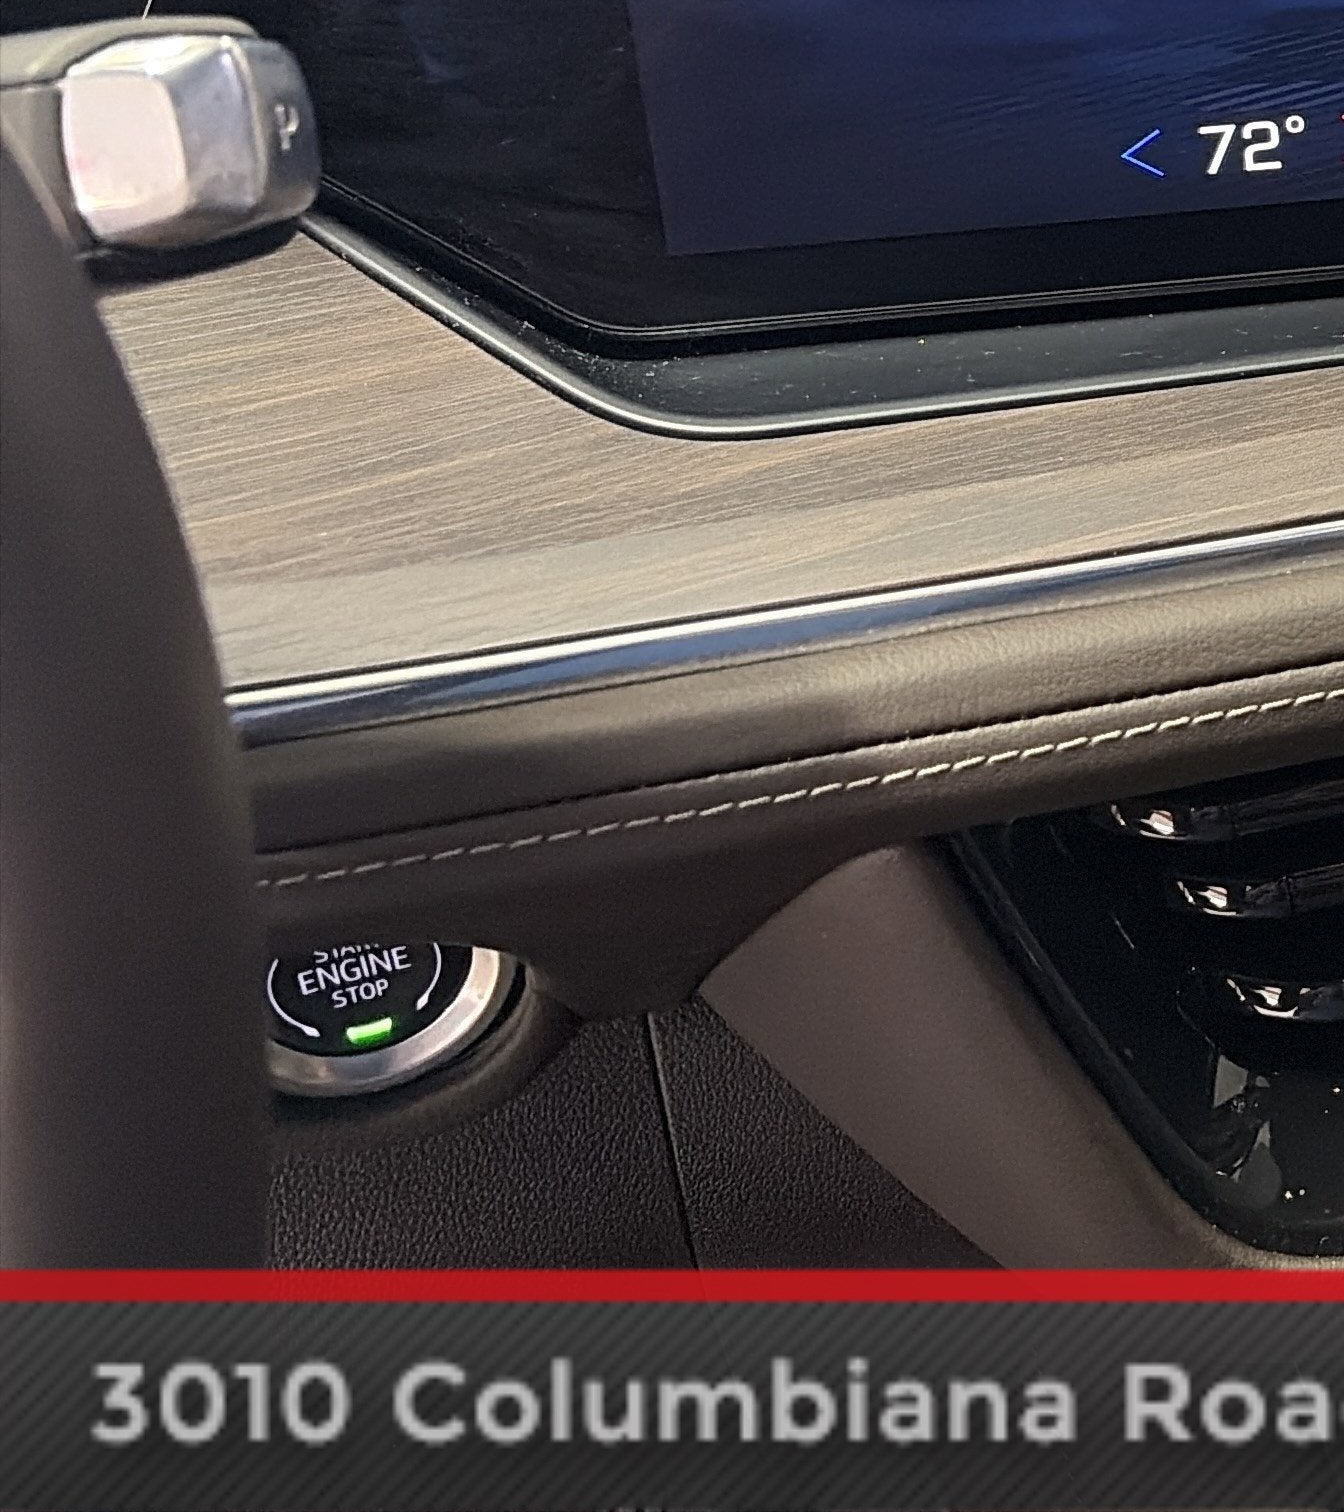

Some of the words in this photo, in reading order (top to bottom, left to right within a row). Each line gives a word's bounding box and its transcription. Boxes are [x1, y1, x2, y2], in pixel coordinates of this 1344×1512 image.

[1198, 116, 1304, 174] 72°
[298, 945, 411, 996] ENGINE
[331, 978, 389, 1008] STOP
